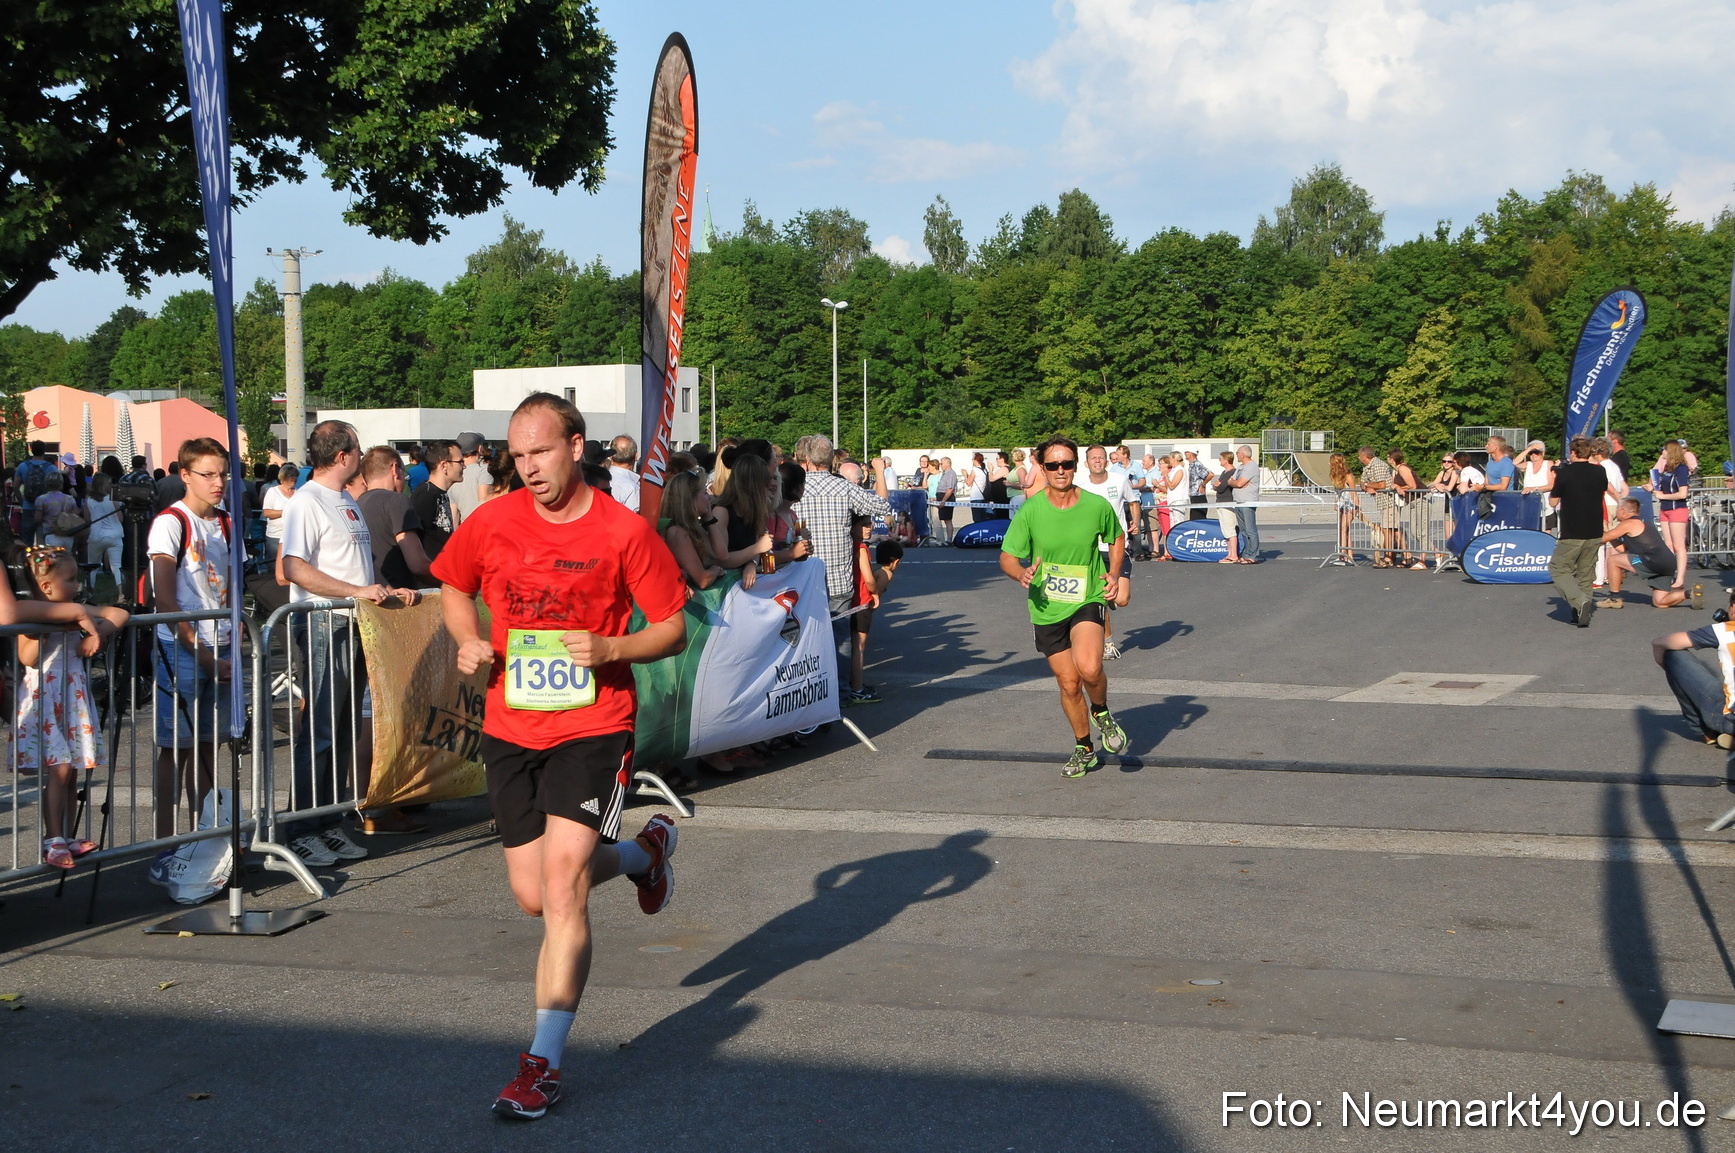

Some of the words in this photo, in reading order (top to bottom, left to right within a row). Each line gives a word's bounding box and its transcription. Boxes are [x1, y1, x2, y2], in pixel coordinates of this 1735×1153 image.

[643, 174, 690, 488] WECHSELSZENE
[1571, 330, 1623, 415] Frischmann
[1185, 537, 1228, 549] Fische
[1047, 576, 1079, 595] 582
[508, 658, 590, 690] 1360
[775, 654, 820, 685] Neumarkter
[765, 674, 829, 720] Lammsbräu
